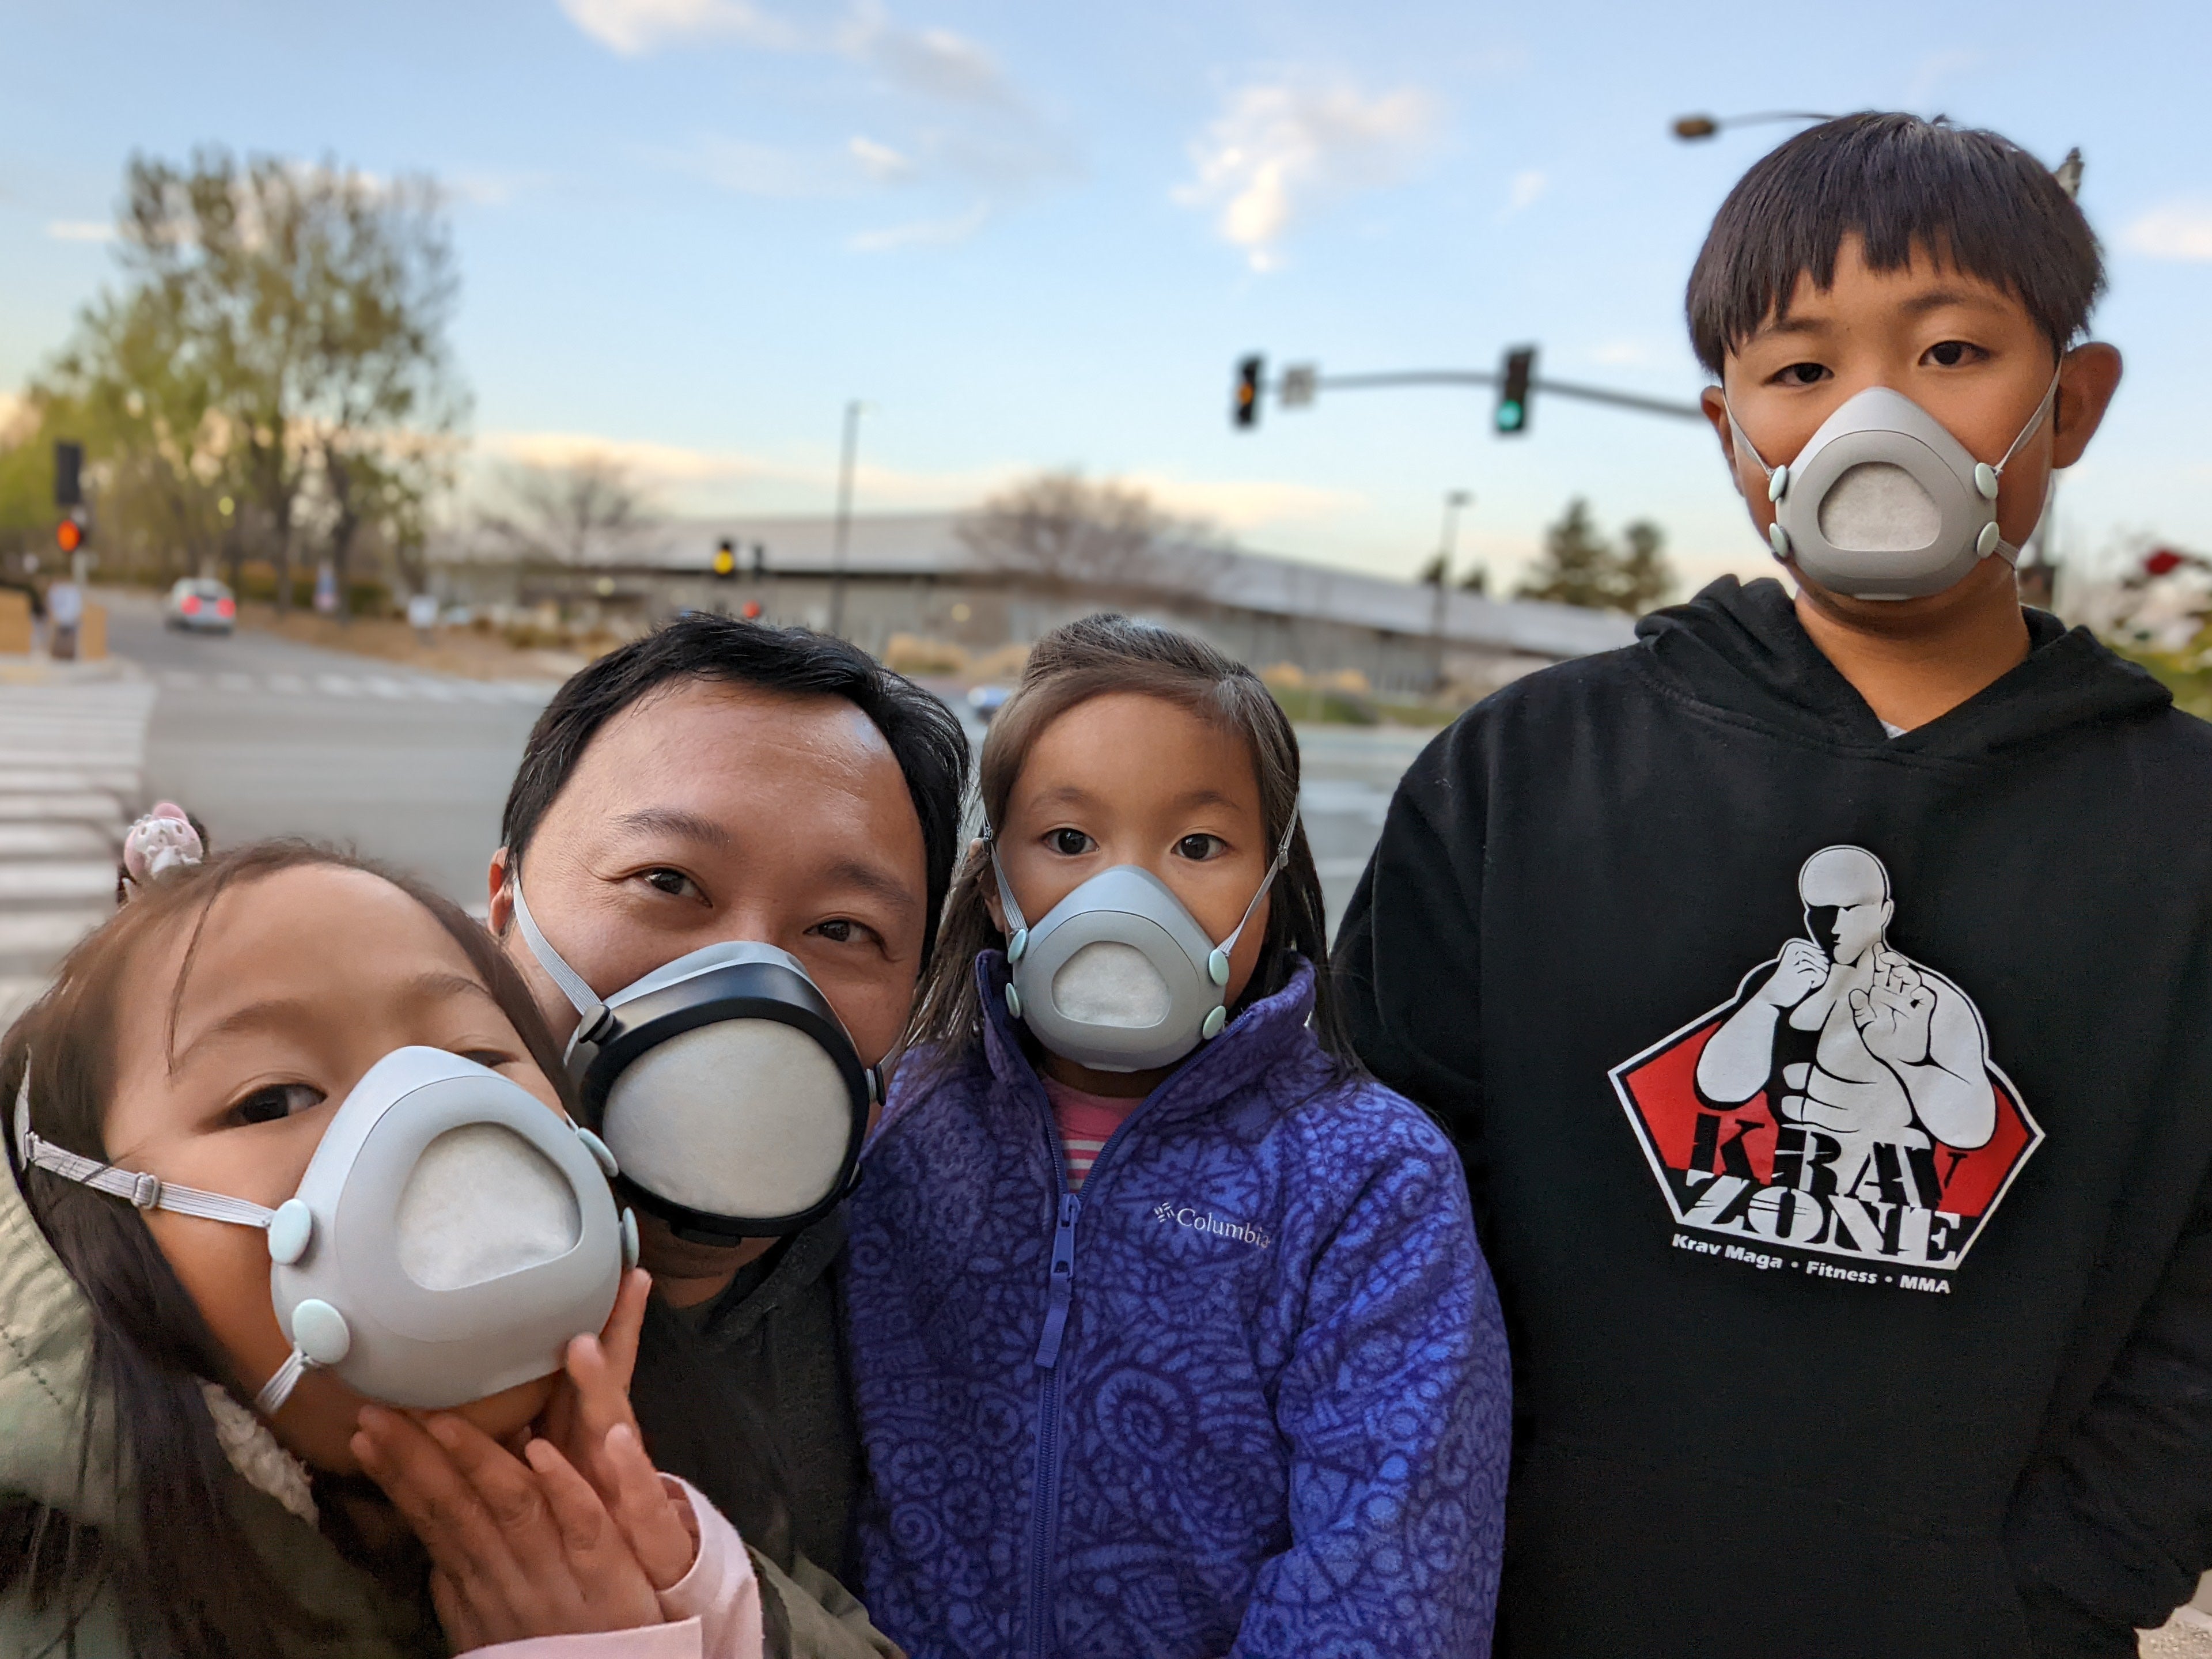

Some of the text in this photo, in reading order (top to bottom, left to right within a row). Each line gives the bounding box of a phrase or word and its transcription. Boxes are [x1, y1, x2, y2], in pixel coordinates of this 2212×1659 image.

[1688, 1113, 1968, 1209] KRAV
[1177, 1208, 1271, 1249] Columbia
[1685, 1169, 1960, 1264] ZONE
[1672, 1234, 1951, 1294] Krav Maga Fitness MMA
